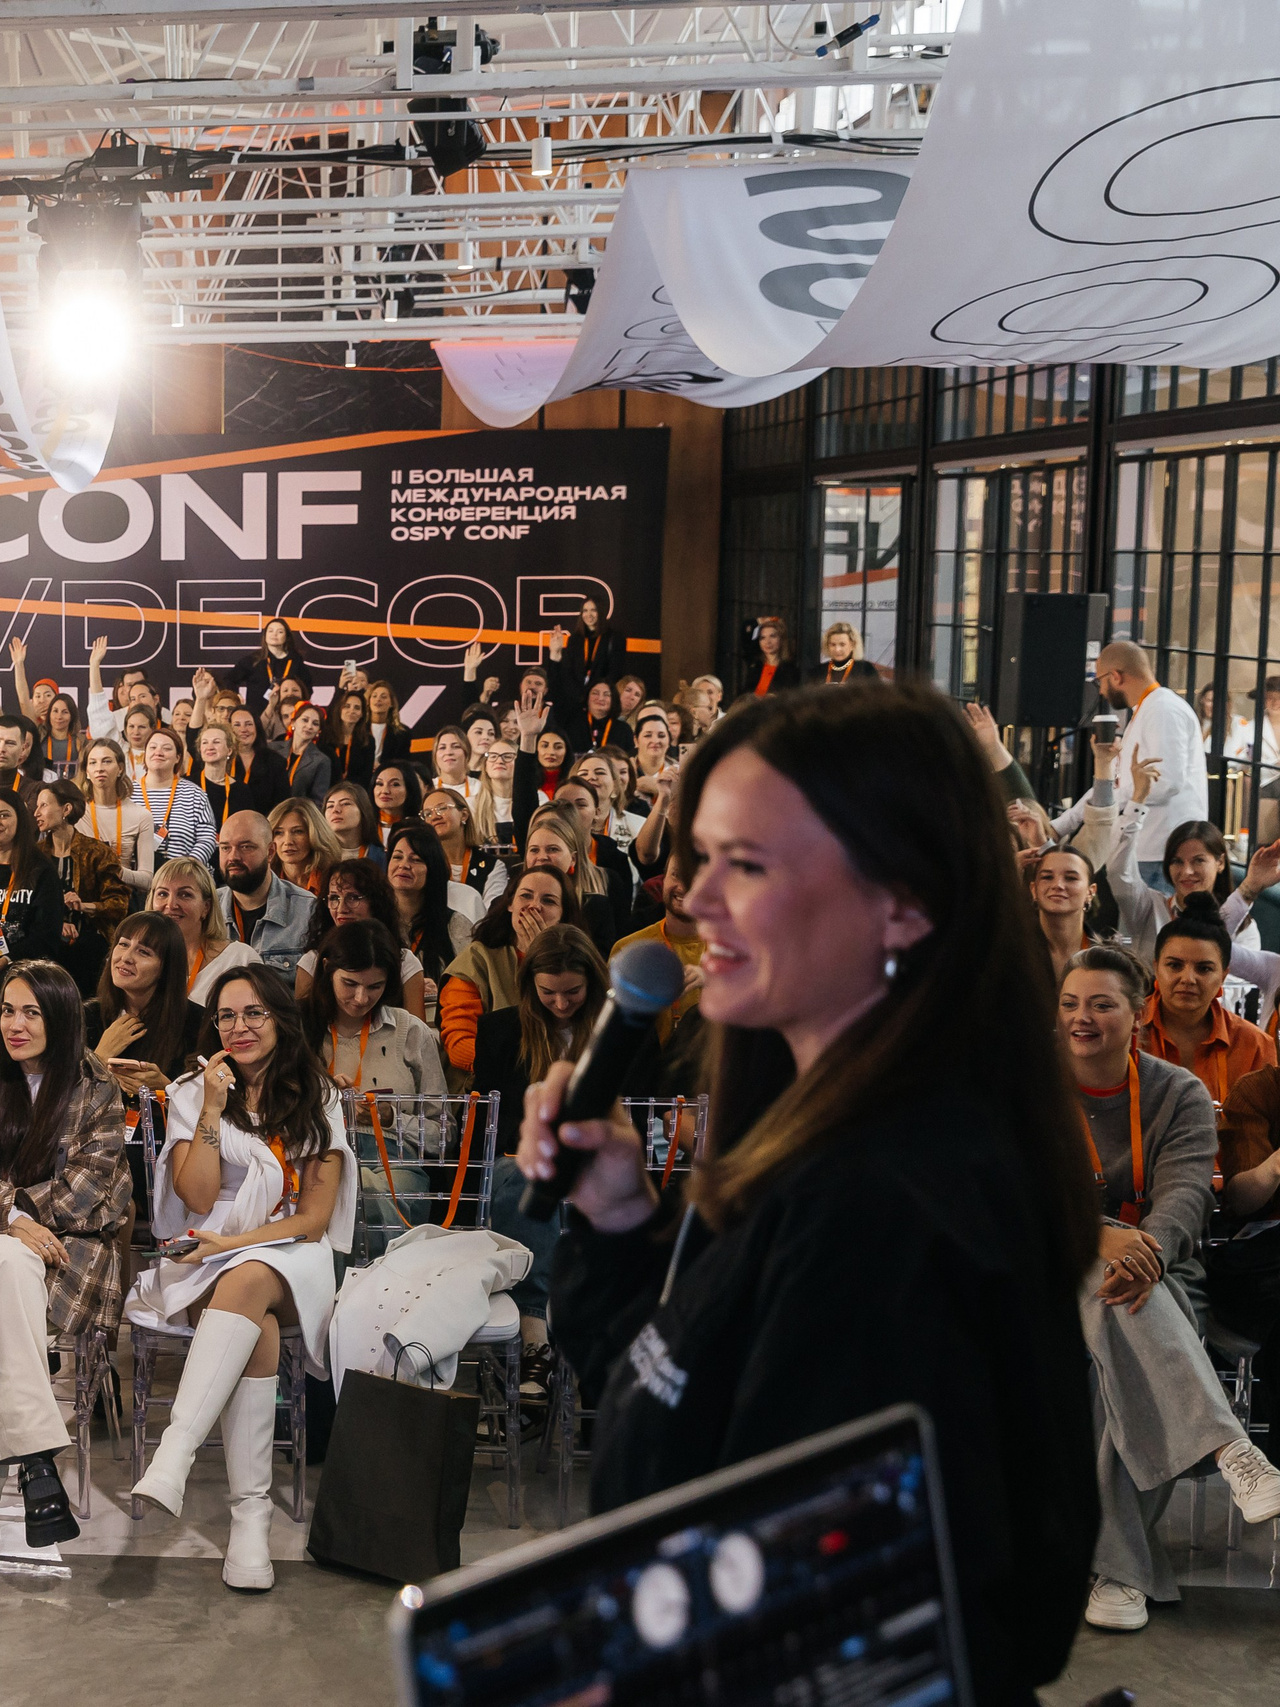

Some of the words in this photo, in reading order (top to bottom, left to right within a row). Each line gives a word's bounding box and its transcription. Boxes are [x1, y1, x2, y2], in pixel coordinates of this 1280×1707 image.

[391, 470, 402, 484] II
[409, 467, 534, 484] БОЛЬШАЯ
[391, 485, 627, 505] МЕЖДУНАРОДНАЯ
[391, 505, 577, 523] КОНФЕРЕНЦИЯ
[391, 526, 456, 541] OSPY
[464, 525, 530, 540] CONF
